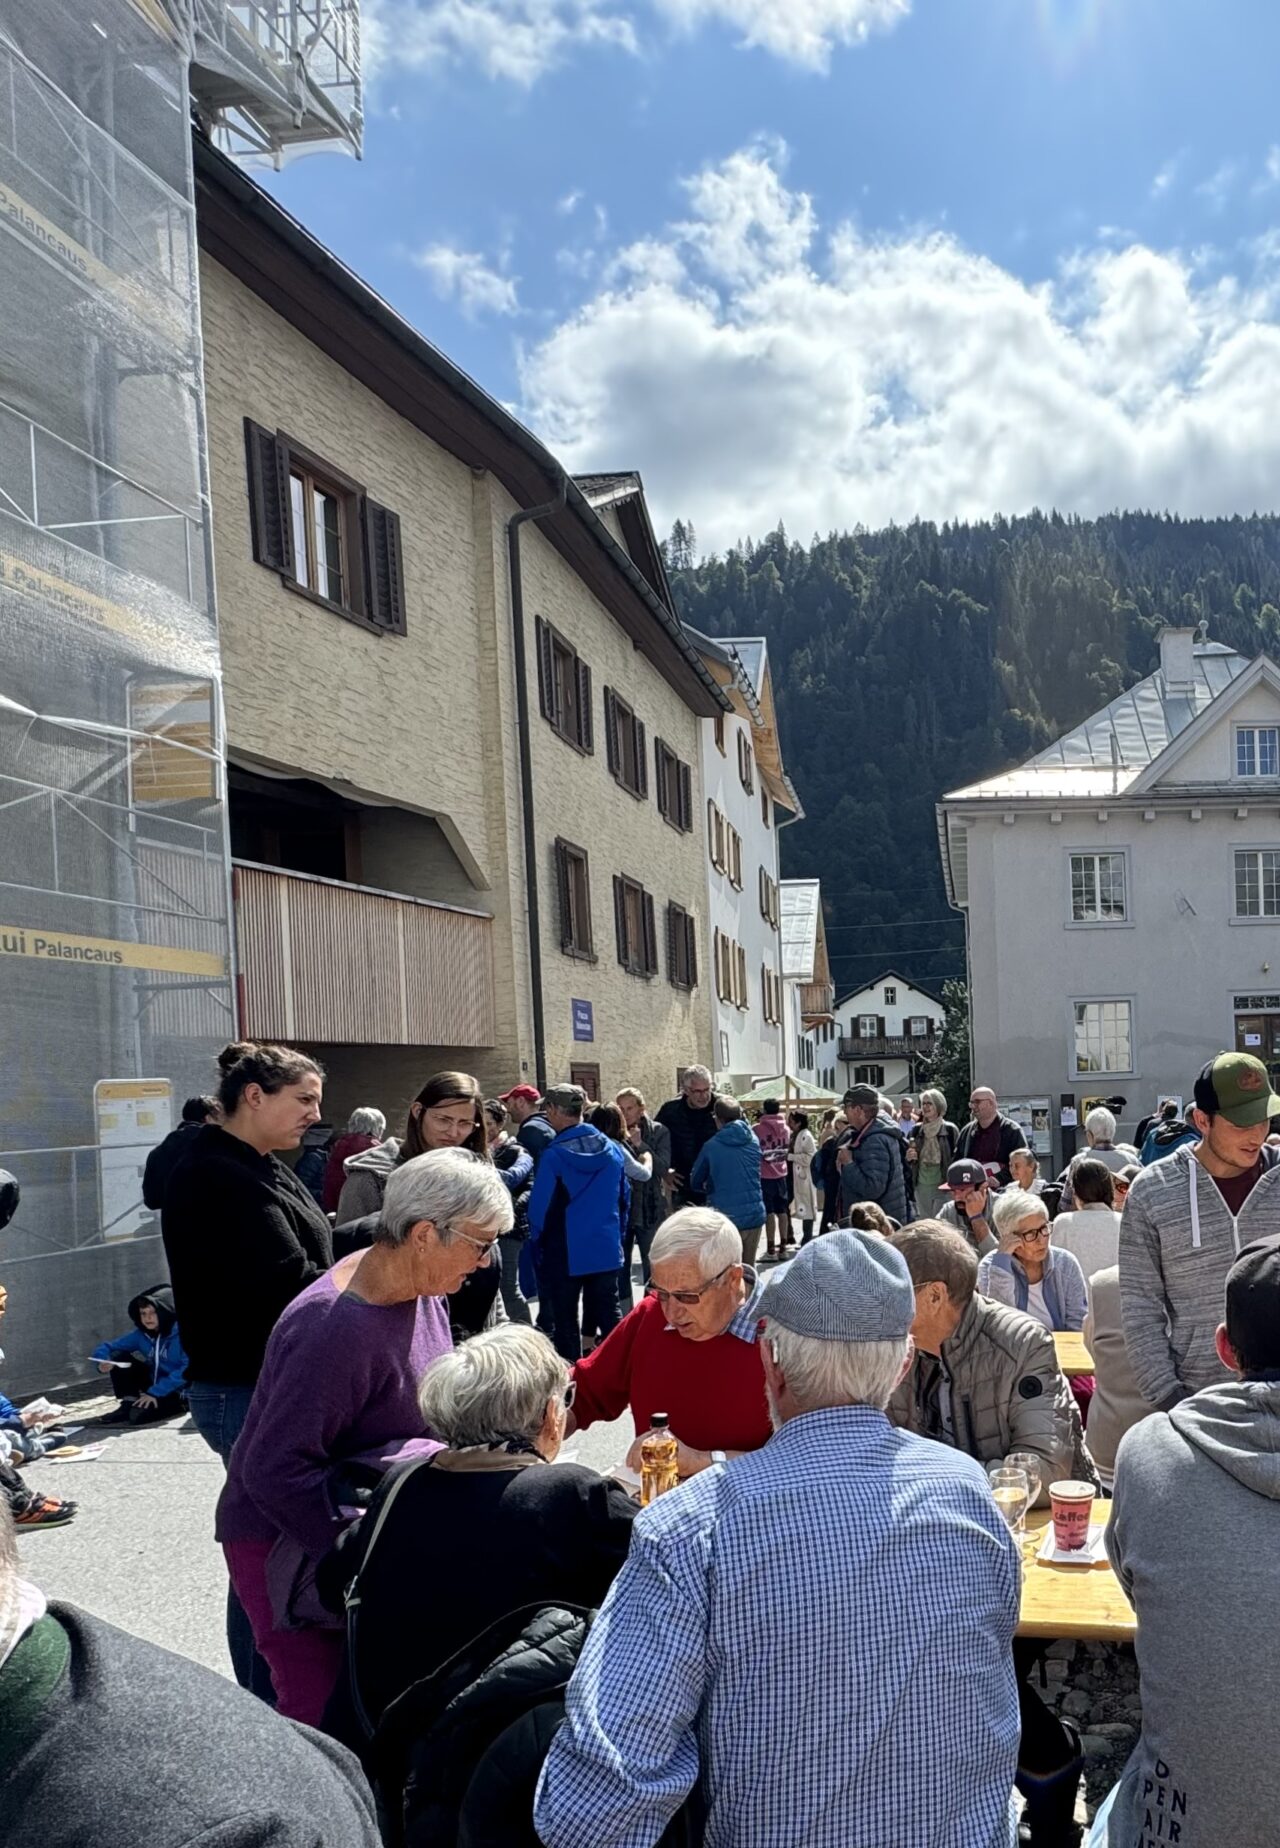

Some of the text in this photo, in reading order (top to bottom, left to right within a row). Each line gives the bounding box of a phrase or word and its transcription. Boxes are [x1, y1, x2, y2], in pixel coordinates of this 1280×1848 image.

[0, 931, 123, 964] ui Palancaus
[1144, 1807, 1181, 1844] AIR
